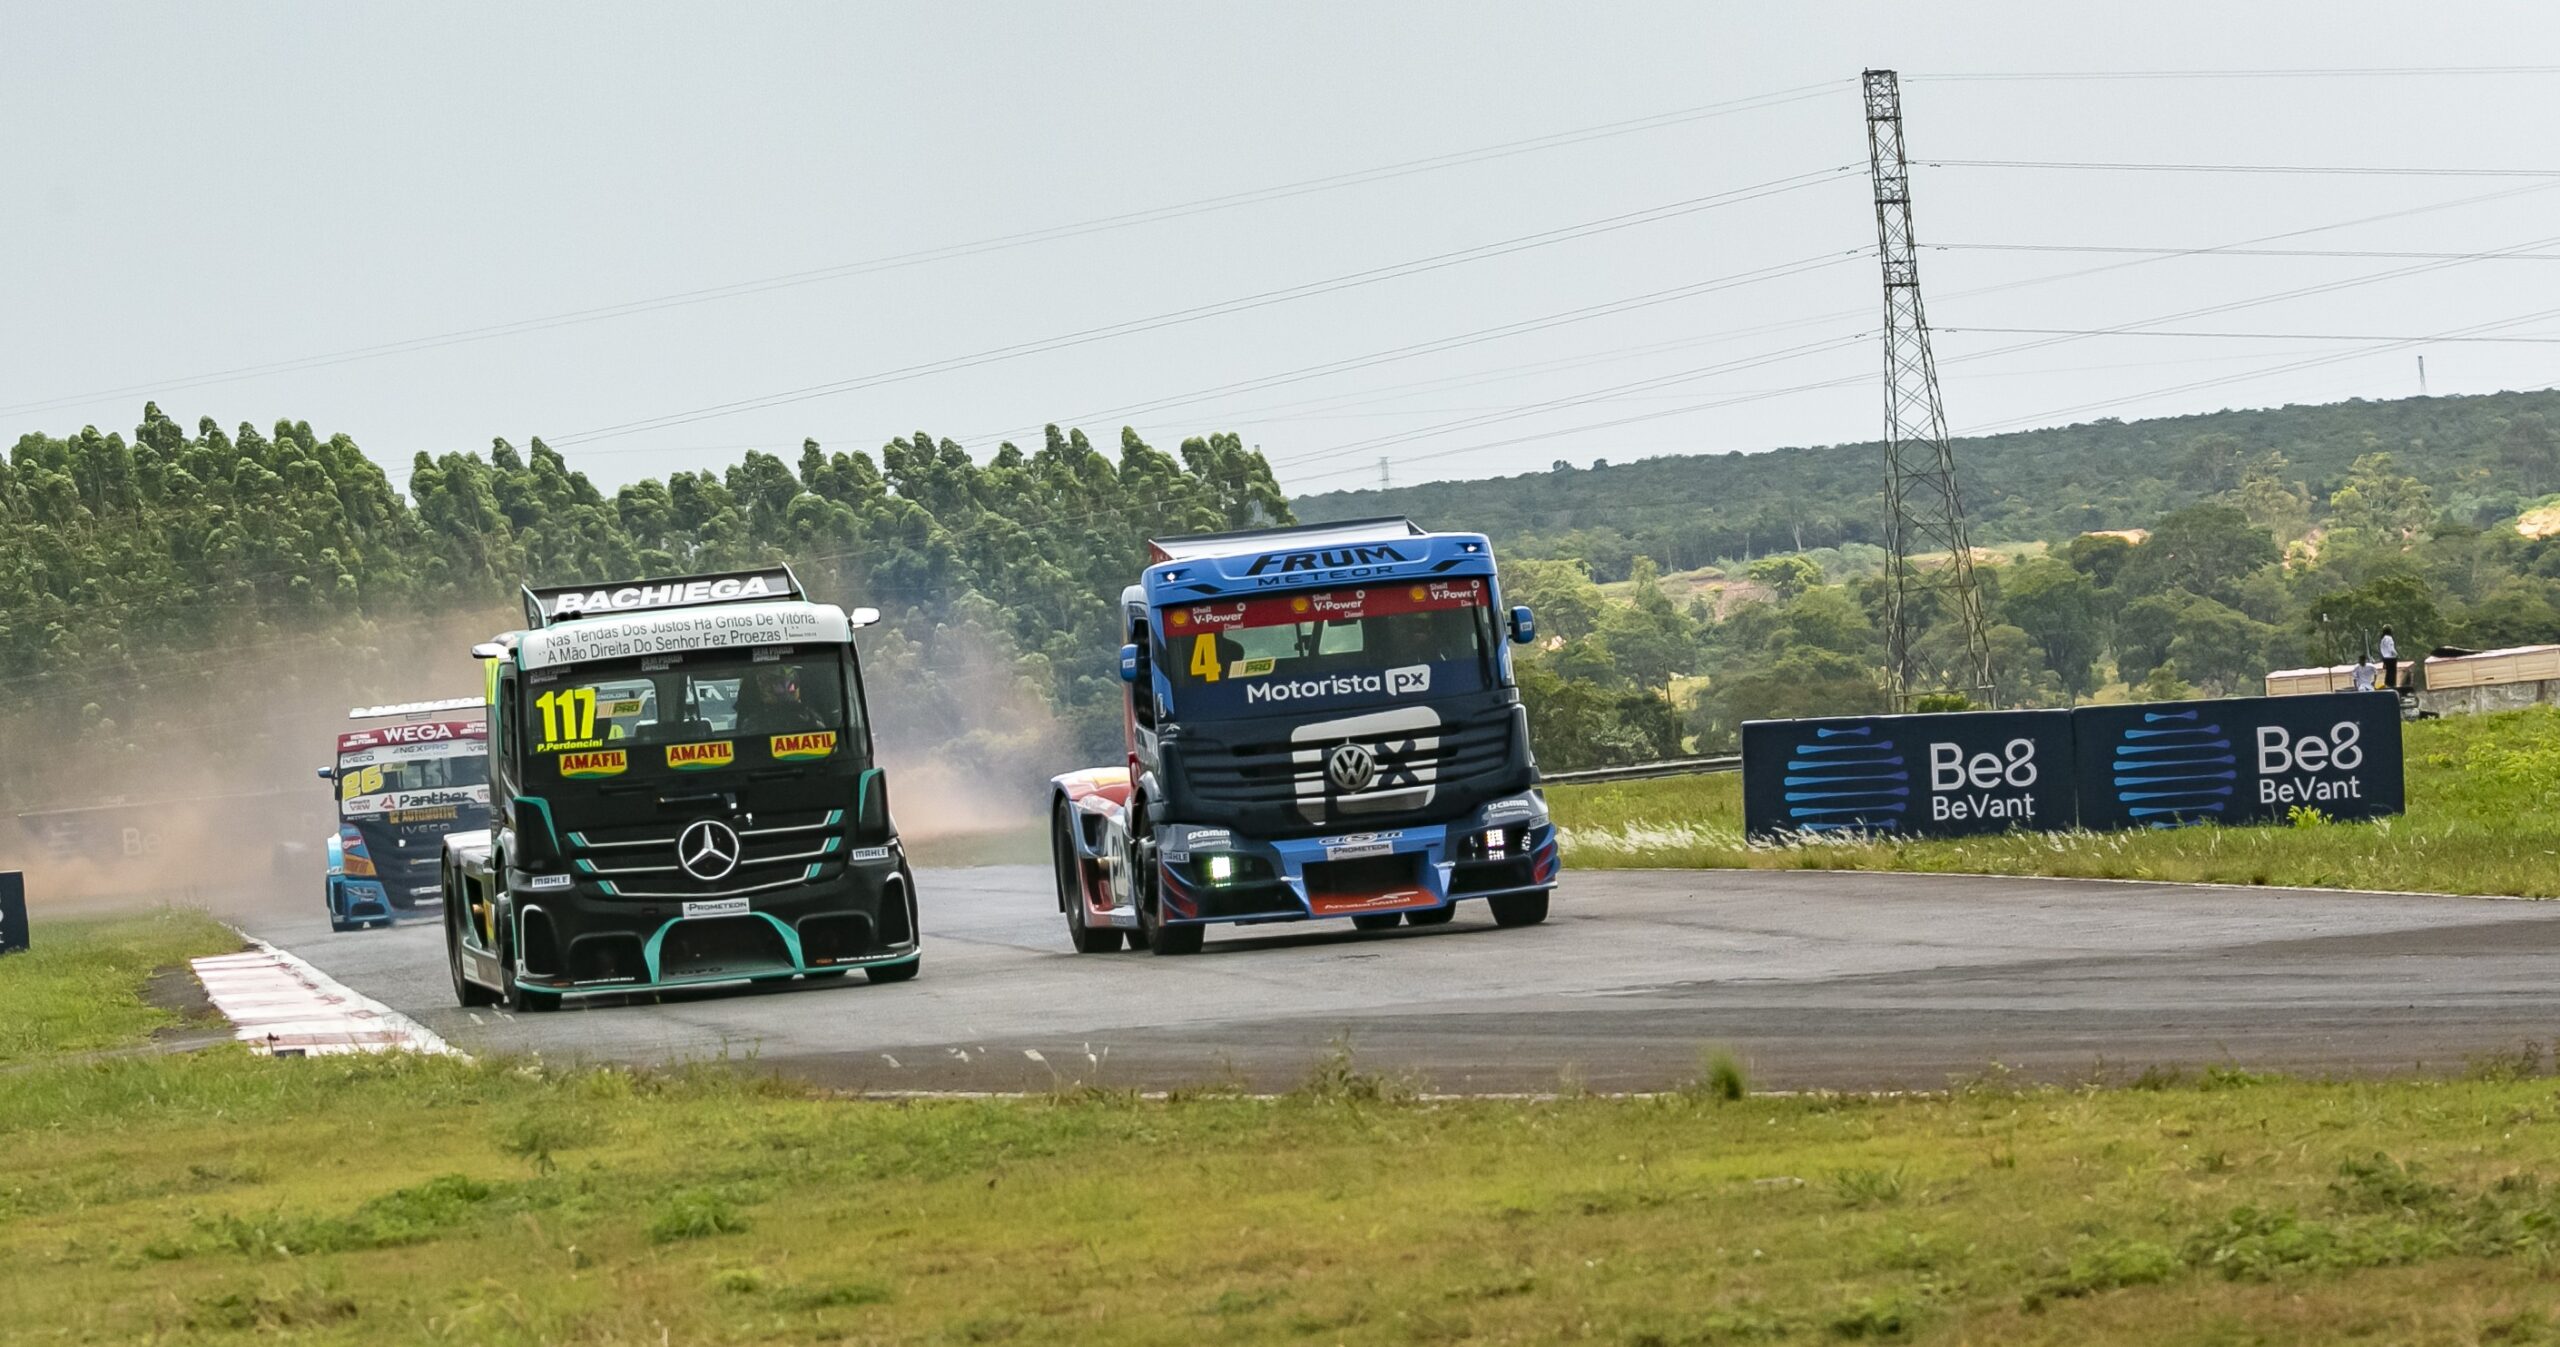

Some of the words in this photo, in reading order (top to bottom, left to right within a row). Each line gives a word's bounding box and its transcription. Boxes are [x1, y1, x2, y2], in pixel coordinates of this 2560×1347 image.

[1245, 543, 1408, 577] FRUM
[1258, 566, 1395, 587] METEOR
[554, 576, 770, 614] BACHIEGA
[1314, 599, 1363, 612] V-Power
[1193, 612, 1243, 625] V-Power
[546, 634, 571, 648] Nas
[574, 626, 619, 643] Tendas
[622, 624, 648, 637] Dos
[651, 618, 691, 634] Justos
[716, 614, 753, 629] Gritos
[755, 613, 774, 626] De
[560, 646, 587, 662] Mão
[590, 641, 631, 658] Direita
[634, 638, 652, 653] Do
[655, 634, 703, 651] Senhor
[703, 632, 728, 647] Fez
[730, 629, 782, 644] Proezas
[1191, 633, 1221, 682] 4
[1247, 673, 1381, 704] Motorista
[1394, 672, 1425, 693] px
[536, 687, 596, 742] 117
[613, 702, 640, 714] PRO
[384, 724, 453, 743] WEGA
[774, 733, 834, 752] AMAFIL
[670, 743, 731, 761] AMAFIL
[2257, 721, 2363, 774] Be8
[563, 752, 625, 770] AMAFIL
[1930, 738, 2038, 791] Be8
[399, 792, 469, 808] Panther
[2260, 776, 2362, 804] BeVant
[1932, 793, 2036, 821] BeVant
[401, 823, 451, 834] IVECO
[855, 848, 888, 859] MAHLE
[534, 876, 569, 886] MAHLE
[688, 901, 748, 913] PROMETEON
